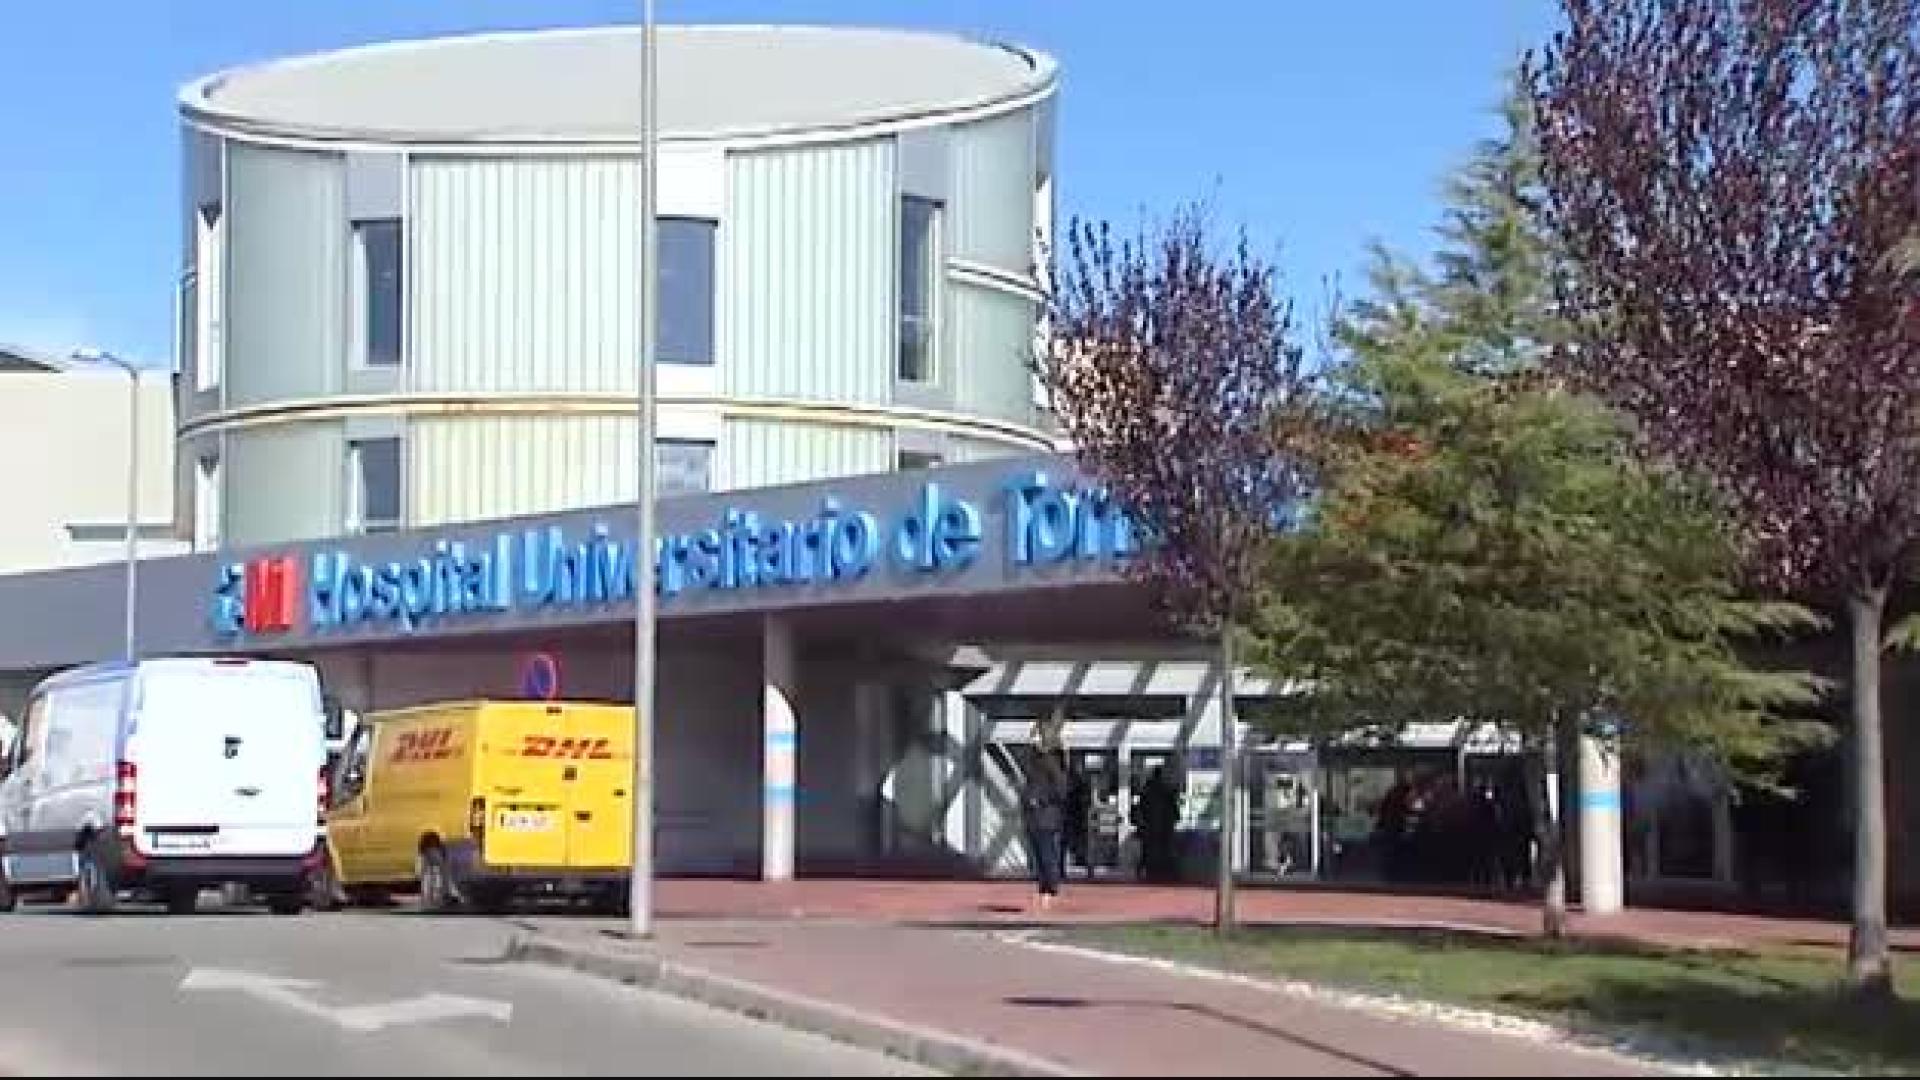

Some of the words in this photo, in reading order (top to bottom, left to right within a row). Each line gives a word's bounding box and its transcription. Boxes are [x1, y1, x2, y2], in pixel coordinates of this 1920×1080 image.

[309, 534, 512, 632] Hospital
[518, 494, 878, 604] Univrsitario
[898, 482, 981, 570] de
[521, 733, 612, 760] DHL
